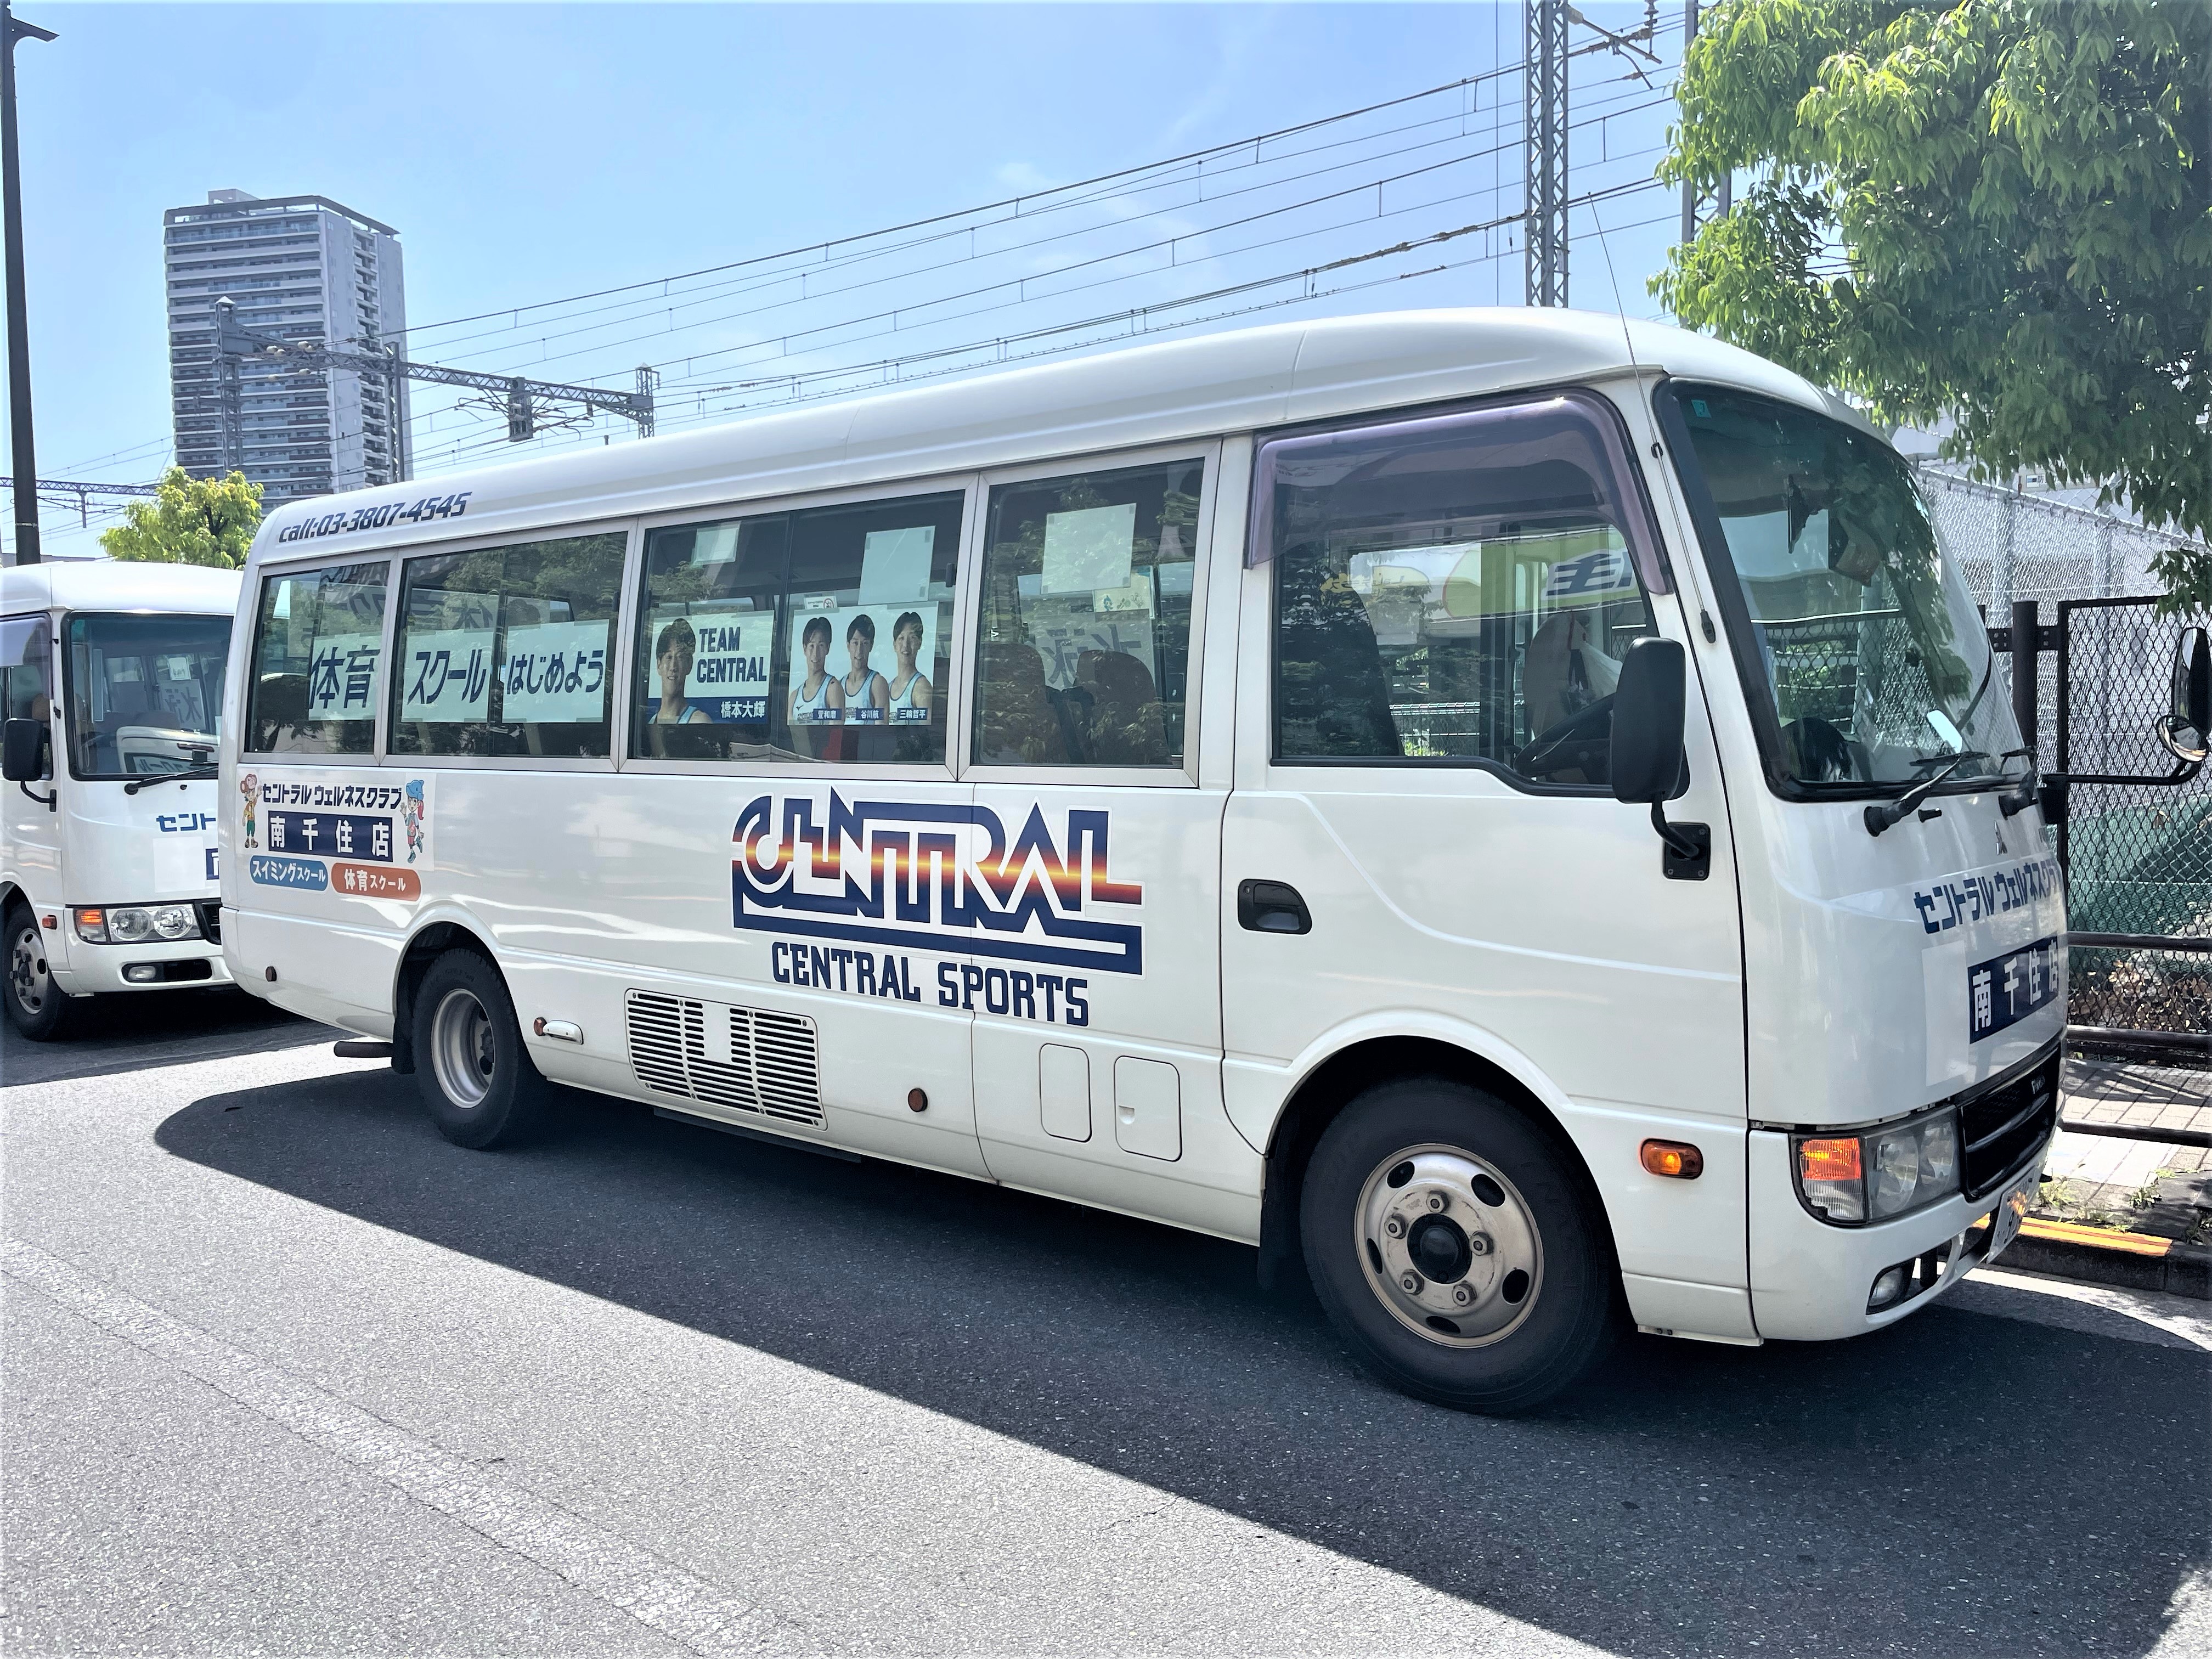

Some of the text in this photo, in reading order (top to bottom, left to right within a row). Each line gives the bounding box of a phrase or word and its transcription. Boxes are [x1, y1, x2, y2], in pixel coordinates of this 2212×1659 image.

[279, 492, 472, 542] call:03-3807-4545
[698, 627, 740, 653] TEAM
[309, 645, 603, 709] 体育 スクール はじめよう
[697, 657, 766, 683] CENTRAL
[721, 701, 765, 718] 橋本大輝
[270, 816, 389, 857] 南千住店
[253, 860, 326, 883] スイミングスクール
[344, 868, 406, 891] 体育スクール
[771, 941, 1088, 1026] CENTRAL SPORTS
[1972, 939, 2058, 1031] 南千住店
